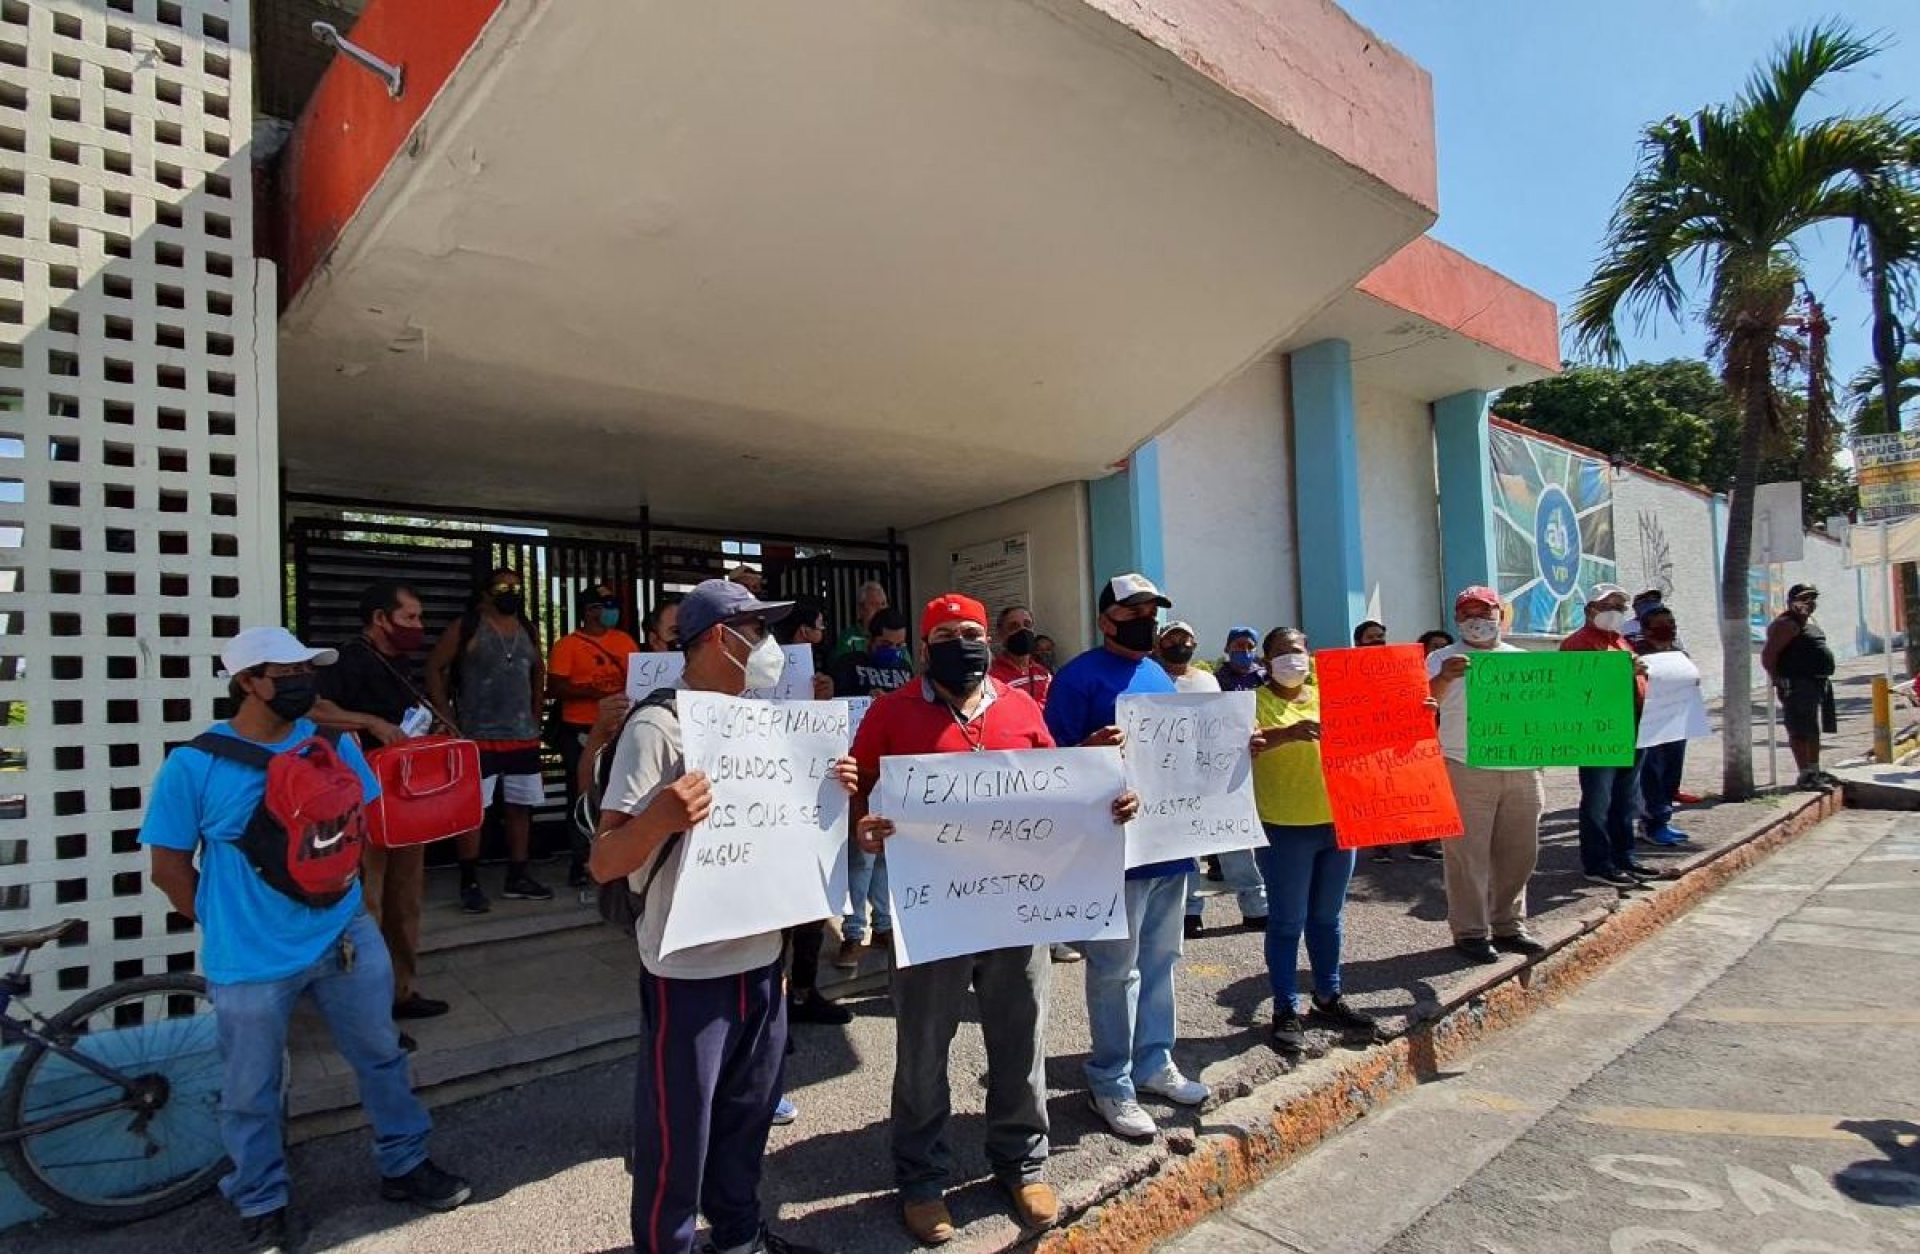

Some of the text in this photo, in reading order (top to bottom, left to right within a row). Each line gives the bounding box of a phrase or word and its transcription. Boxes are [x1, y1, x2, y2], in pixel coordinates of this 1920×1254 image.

[720, 704, 849, 739] GOBERNADOR
[707, 754, 793, 784] UBILADOS
[747, 802, 789, 828] QUE
[936, 817, 1054, 844] EL PAGO
[696, 842, 752, 866] PAGUE
[903, 873, 1045, 910] DE NUESTRO
